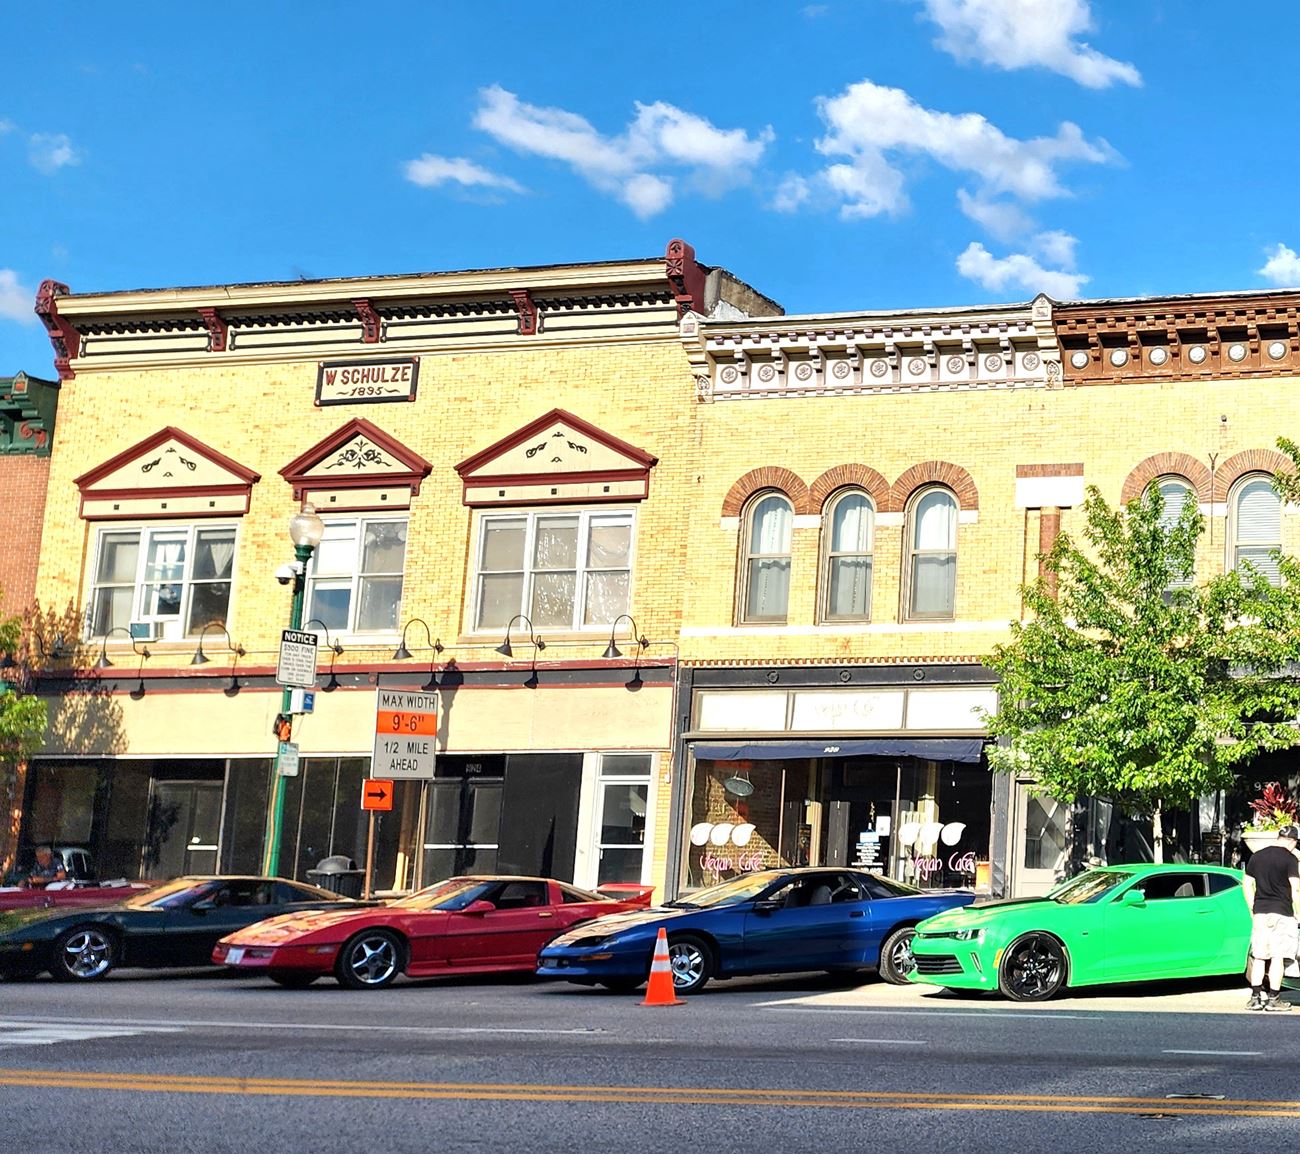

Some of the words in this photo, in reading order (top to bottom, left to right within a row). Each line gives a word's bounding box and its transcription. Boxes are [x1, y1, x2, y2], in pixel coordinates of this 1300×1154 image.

[325, 369, 337, 386] W
[340, 366, 411, 385] SCHULZE
[349, 386, 383, 396] 1895
[284, 631, 315, 645] NOTICE
[382, 694, 403, 708] MAX
[407, 695, 435, 709] WIDTH
[392, 714, 424, 732] 9'-6"
[384, 741, 399, 754] 1/2
[406, 741, 428, 755] MILE
[389, 758, 418, 771] AHEAD
[700, 853, 733, 880] Vegan
[912, 854, 943, 881] Vegan
